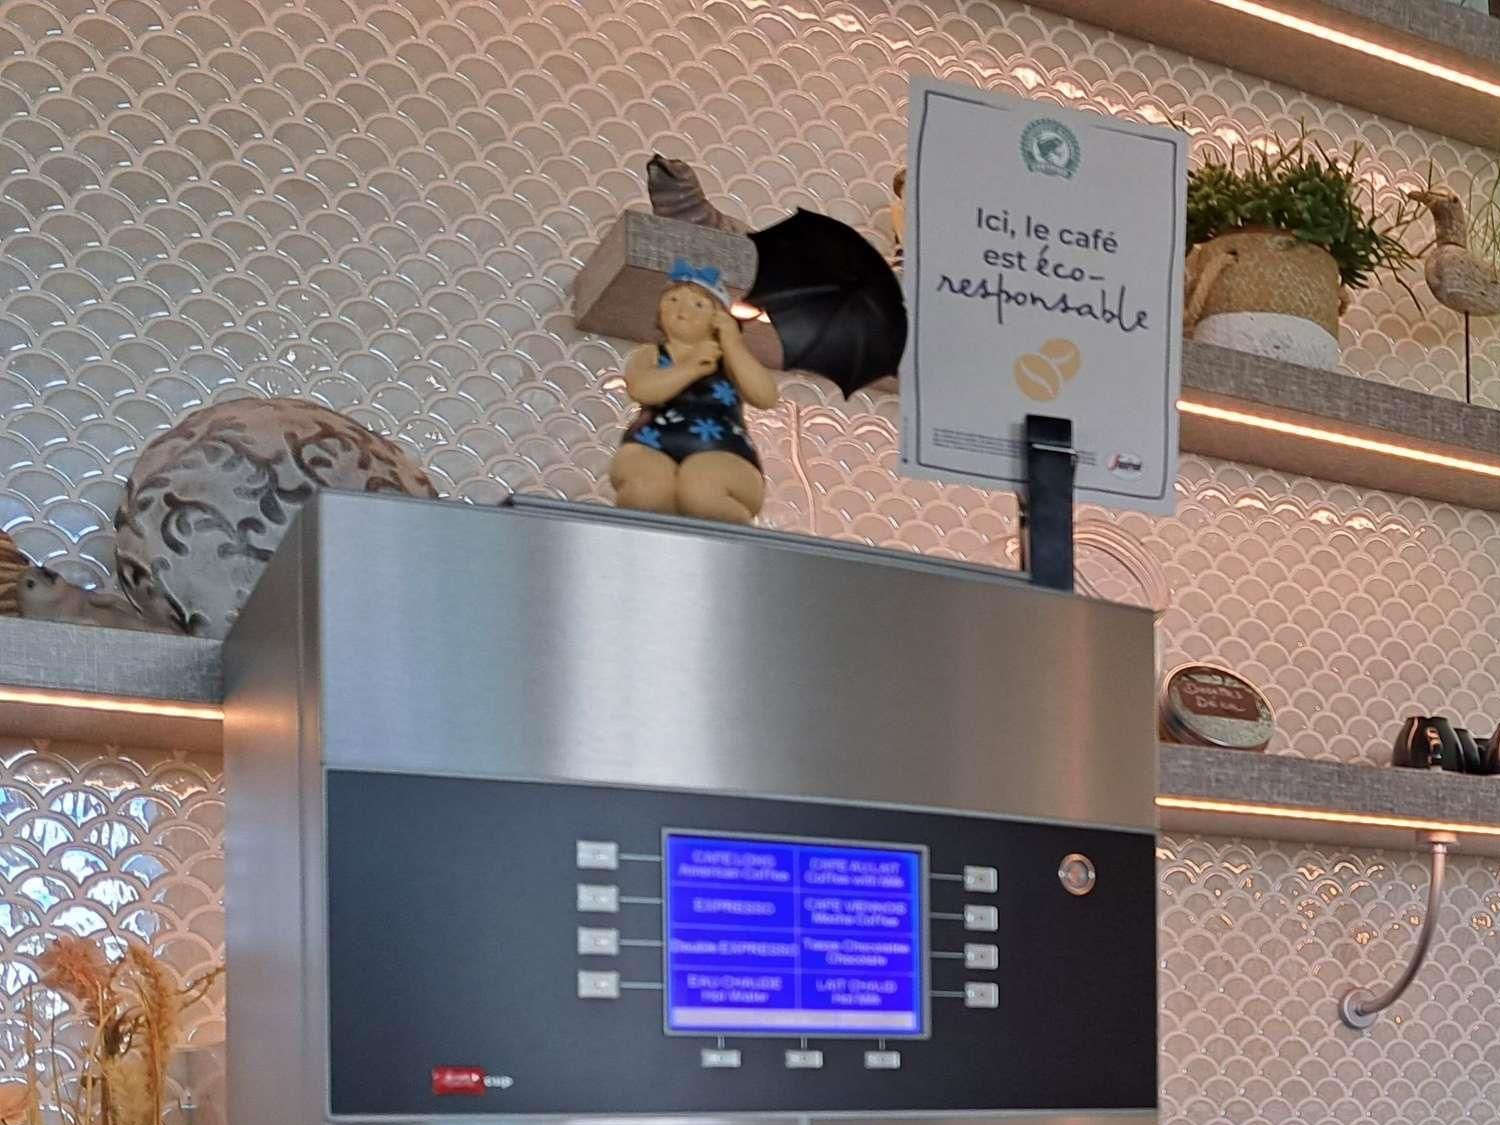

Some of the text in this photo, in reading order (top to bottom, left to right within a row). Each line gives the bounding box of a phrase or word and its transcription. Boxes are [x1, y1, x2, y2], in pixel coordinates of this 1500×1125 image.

[976, 207, 1119, 253] Ici, le café
[983, 244, 1105, 282] est éco-
[937, 273, 1149, 332] responsable
